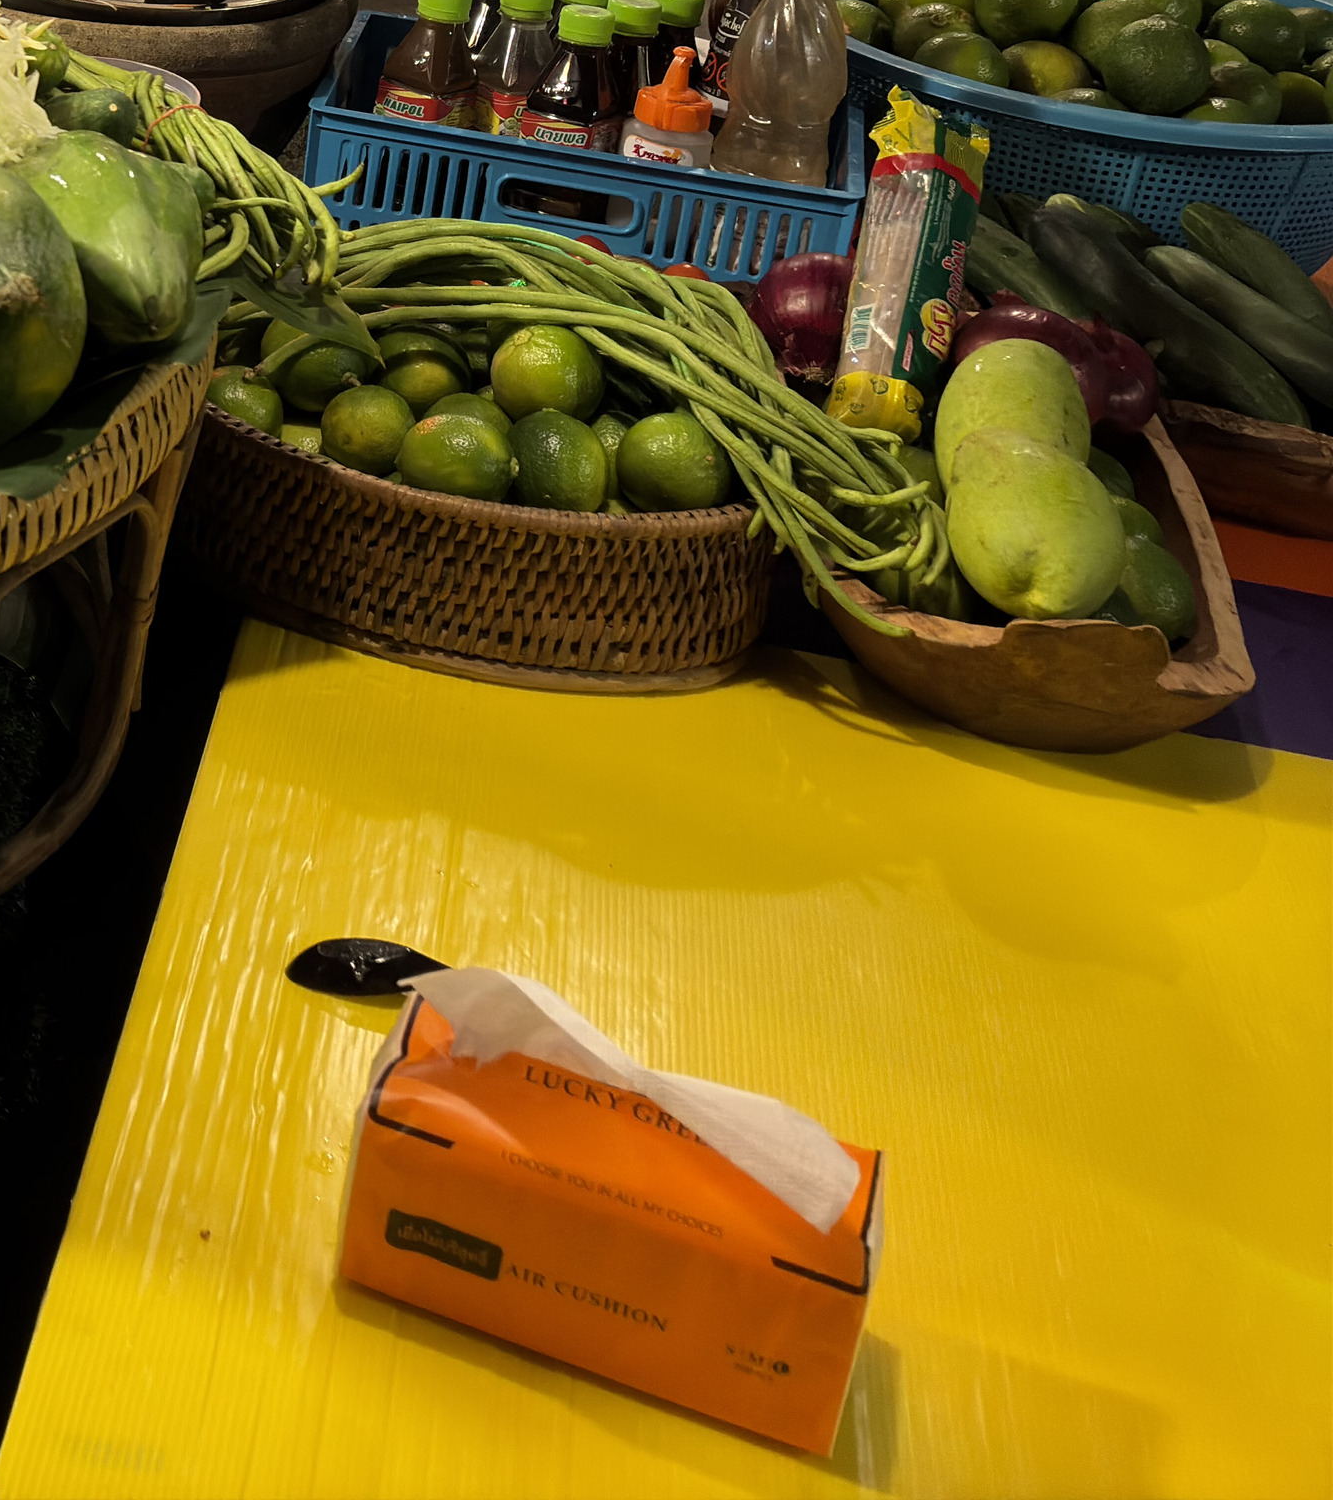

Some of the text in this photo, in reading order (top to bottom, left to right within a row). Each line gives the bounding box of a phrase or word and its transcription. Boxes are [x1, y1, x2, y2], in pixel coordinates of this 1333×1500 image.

[534, 127, 587, 146] นายพล
[524, 1065, 625, 1113] LUCKY
[508, 1264, 667, 1333] AIR CUSHION
